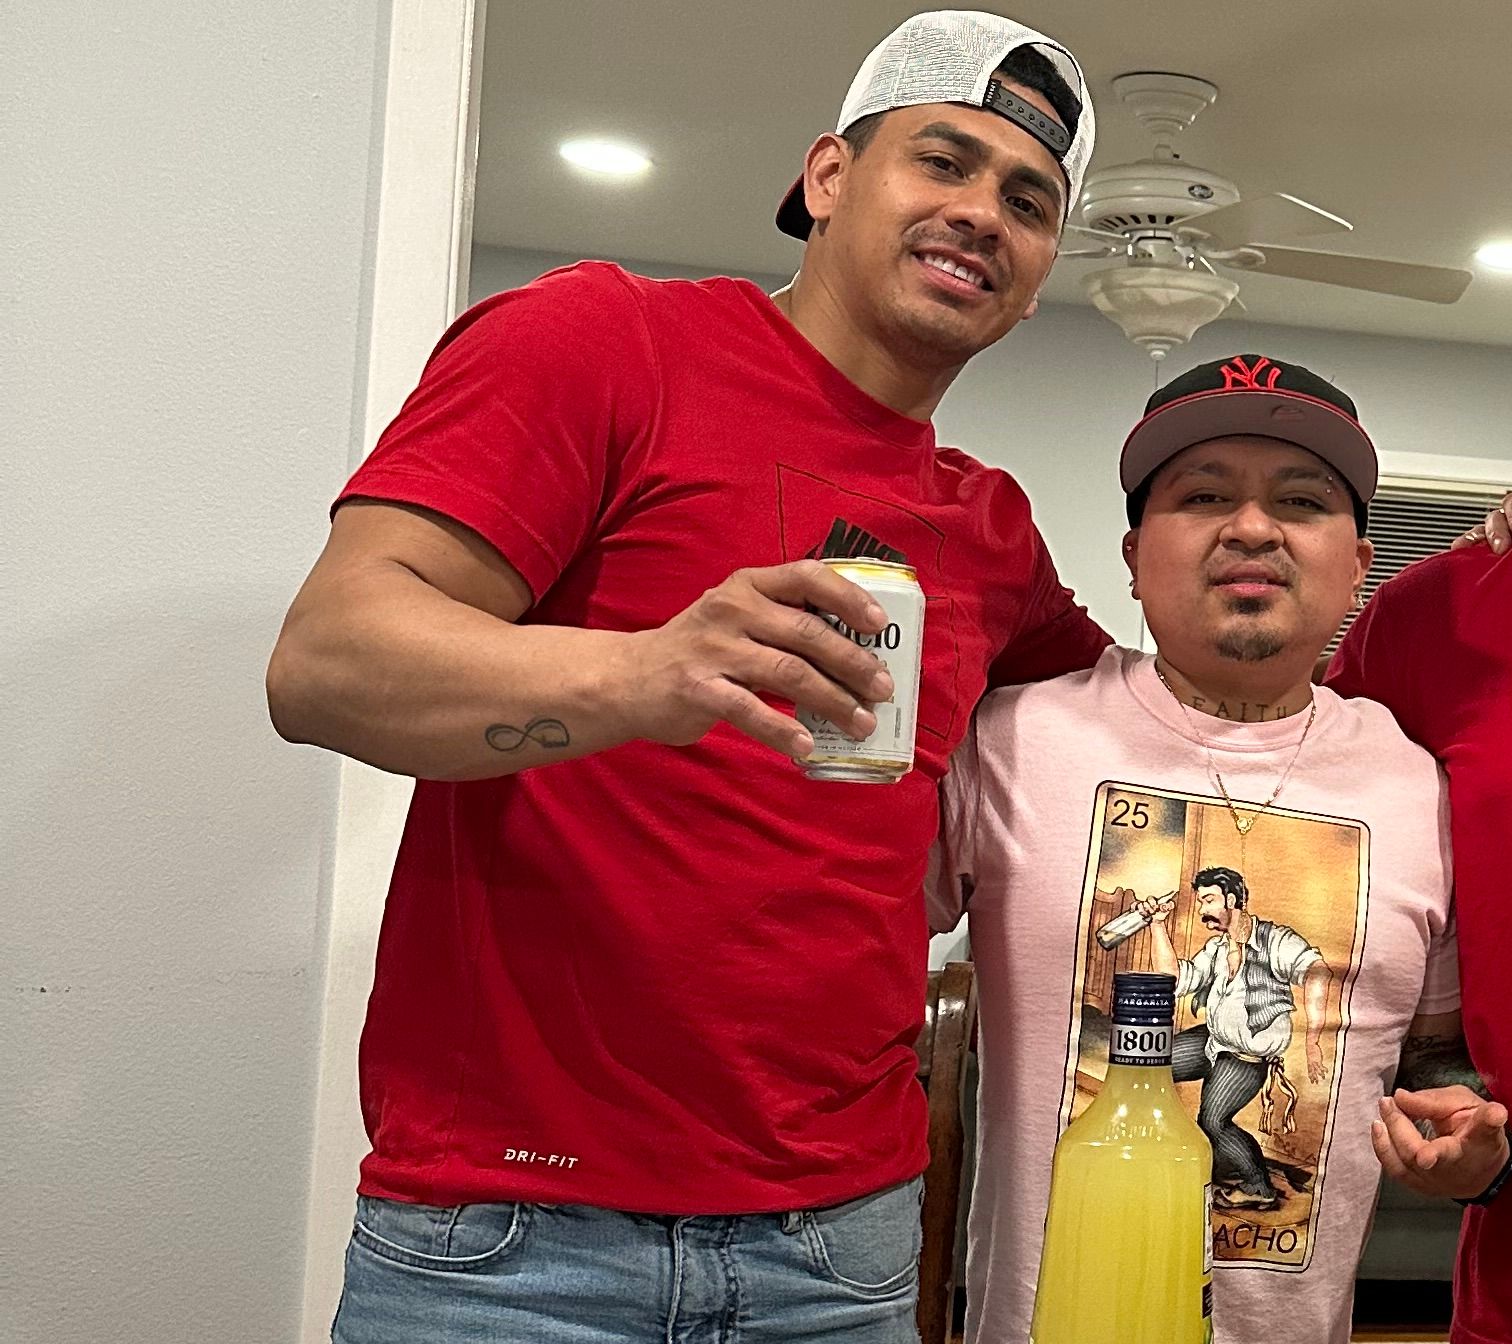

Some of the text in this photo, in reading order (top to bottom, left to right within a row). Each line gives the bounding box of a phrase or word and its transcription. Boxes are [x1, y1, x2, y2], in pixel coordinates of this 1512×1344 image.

[1111, 799, 1149, 829] 25
[1117, 1030, 1167, 1053] 1800
[504, 1148, 579, 1168] DRI-FIT
[1213, 1223, 1298, 1254] ACHO
